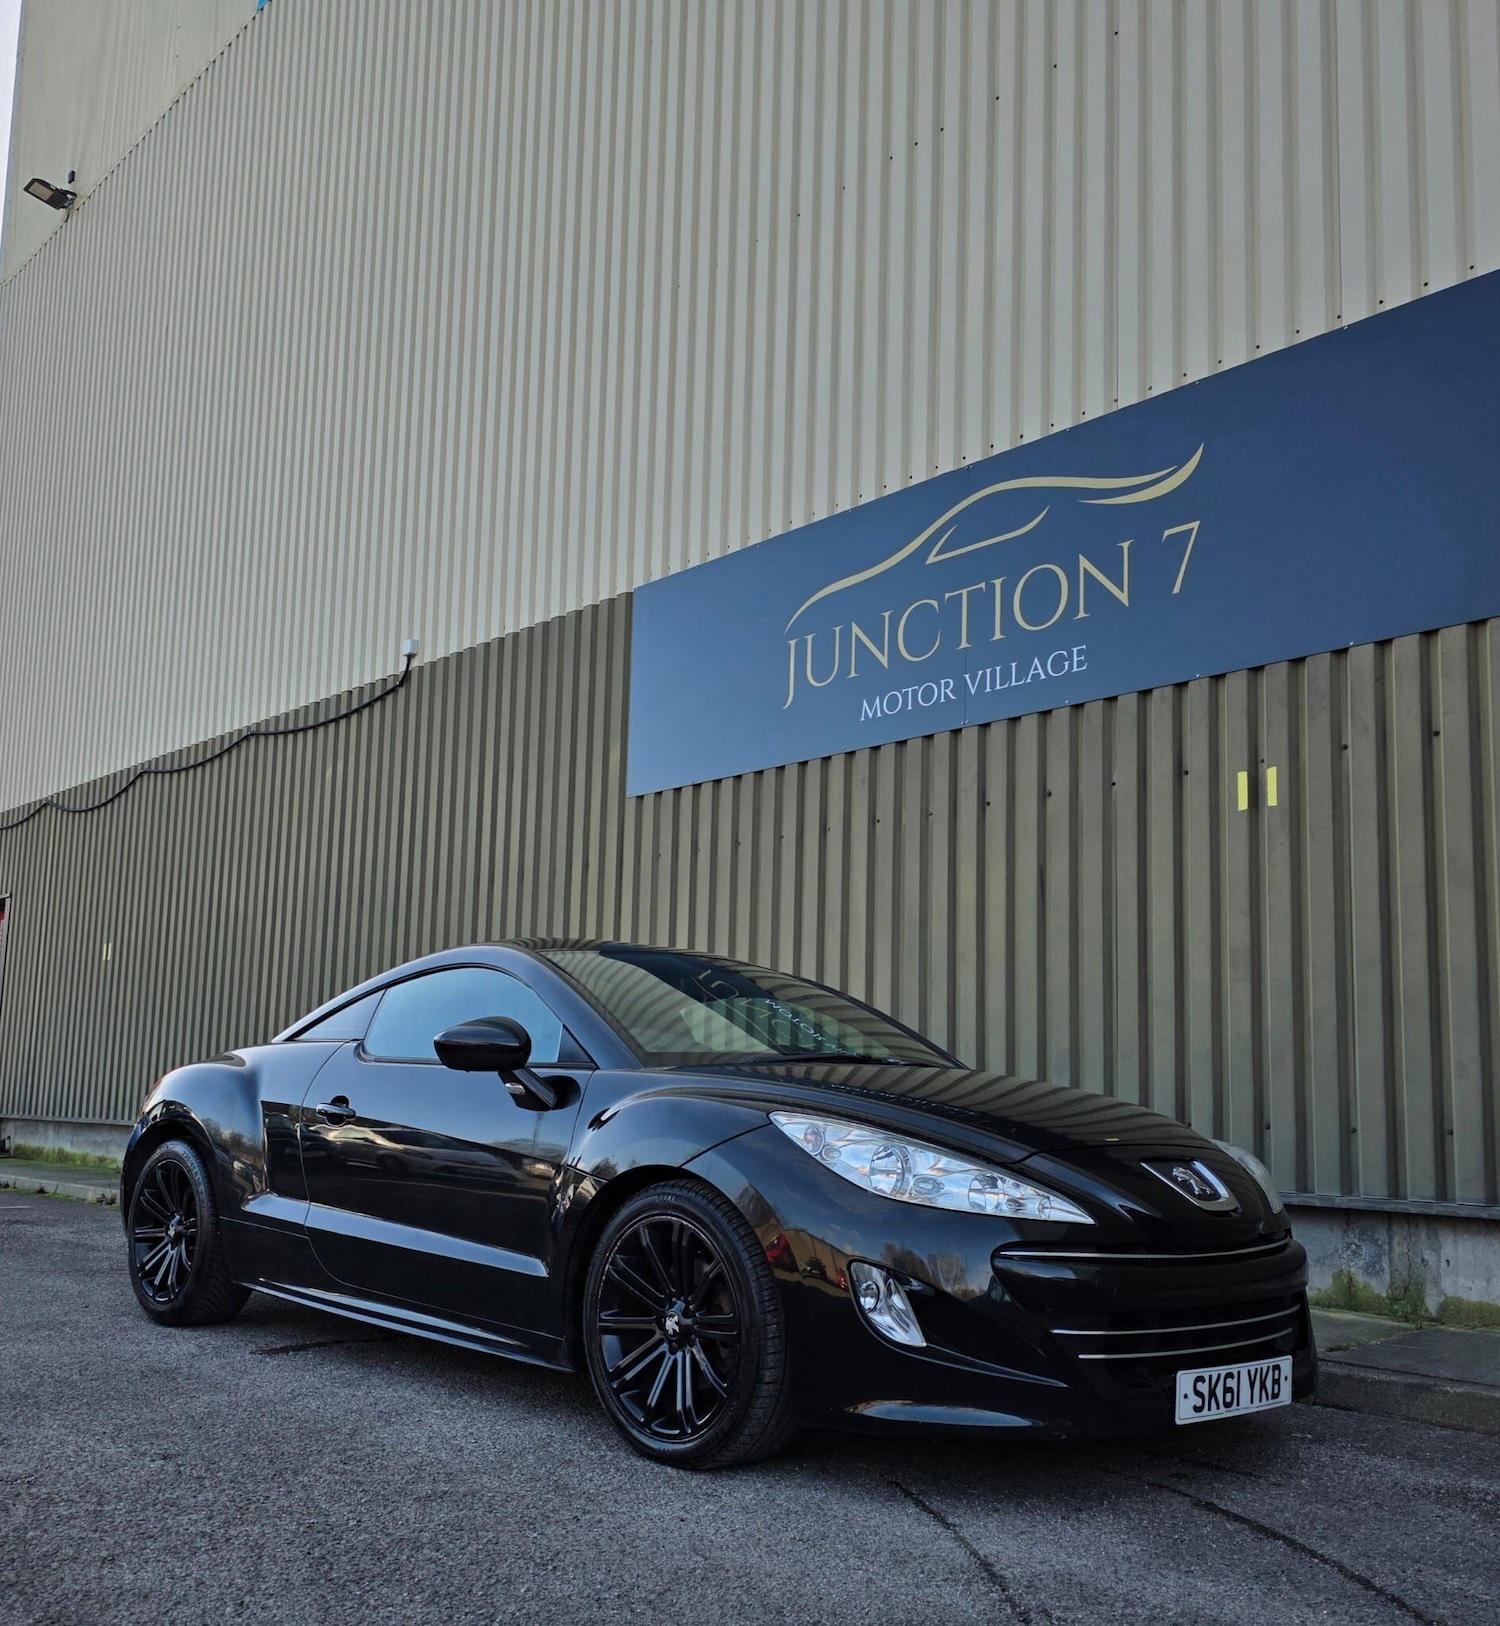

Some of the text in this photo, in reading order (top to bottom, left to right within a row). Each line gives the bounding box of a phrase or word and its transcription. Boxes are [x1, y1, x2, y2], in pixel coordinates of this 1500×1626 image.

[783, 520, 1201, 710] JUNCTION 7
[859, 644, 1089, 722] MOTOR VILLAGE
[1192, 1363, 1281, 1413] SK61 YKB
